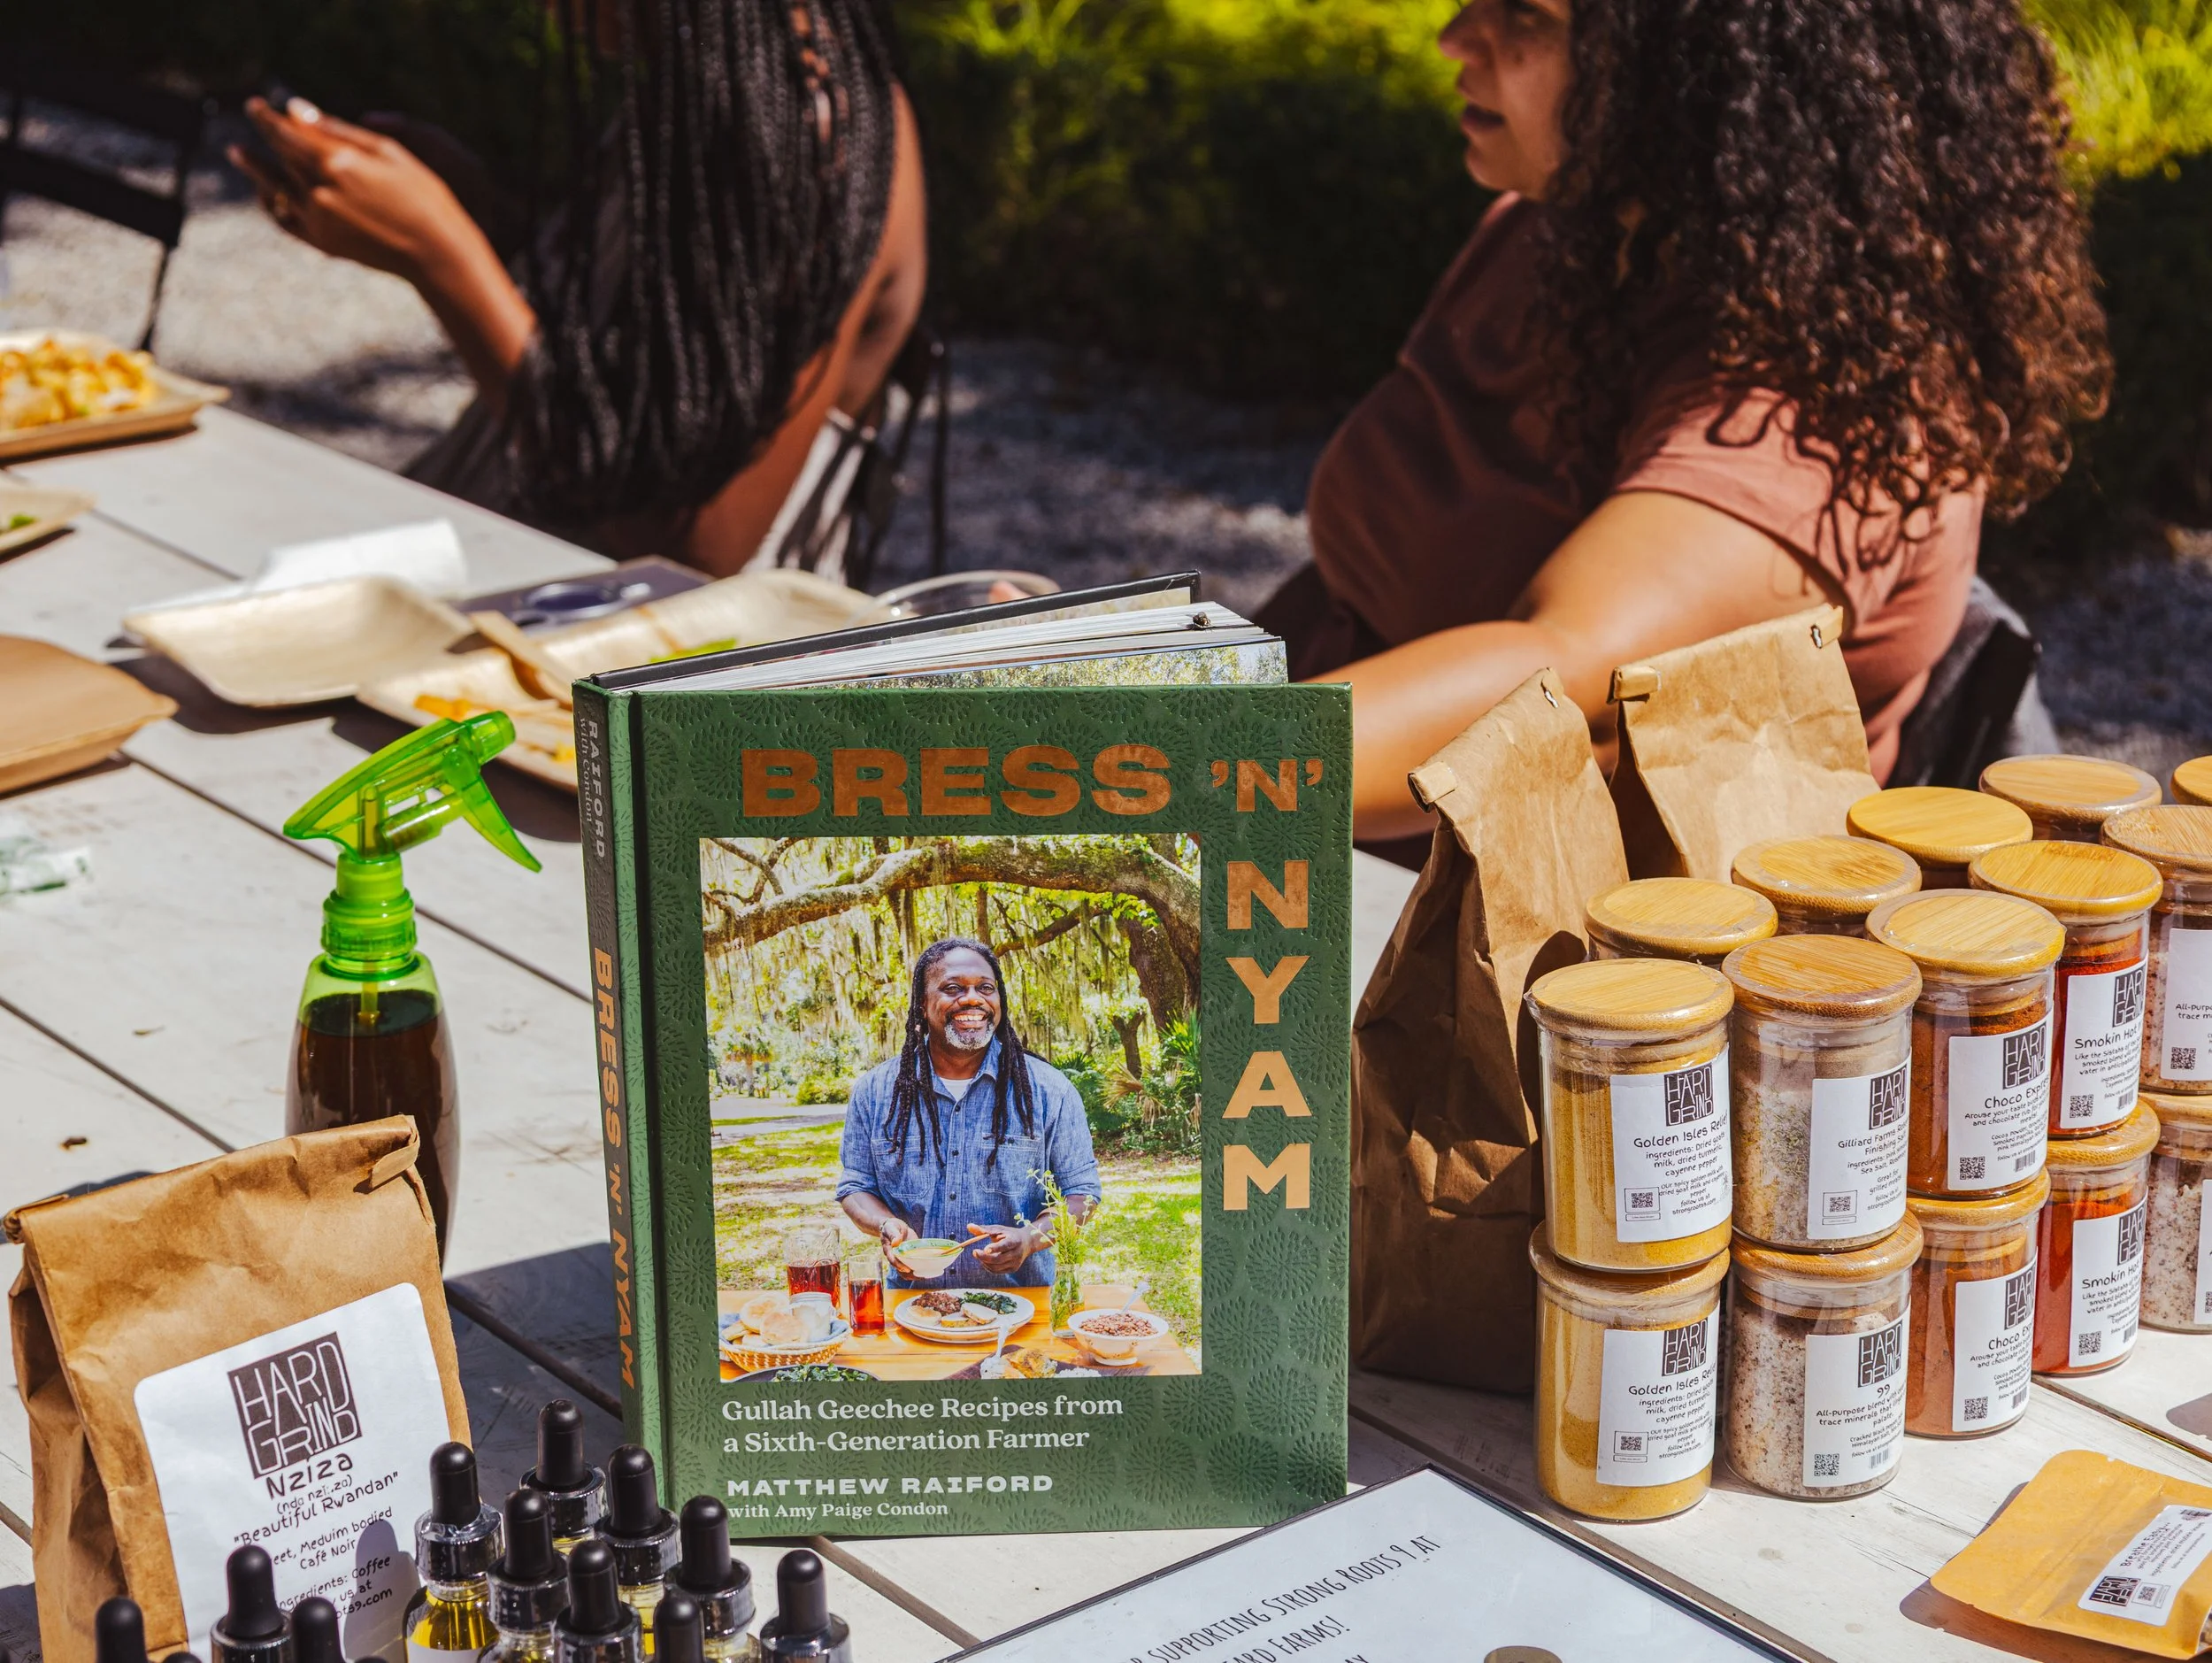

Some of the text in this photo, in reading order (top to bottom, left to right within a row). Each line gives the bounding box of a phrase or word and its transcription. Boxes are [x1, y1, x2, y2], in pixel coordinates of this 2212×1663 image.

[580, 718, 592, 822] with Condon
[741, 744, 1172, 817] BRESS
[588, 720, 605, 858] RAIFORD
[2176, 1003, 2212, 1012] All-purp
[1222, 859, 1312, 1211] NYAM
[2074, 1033, 2121, 1049] Smokin
[2124, 1026, 2137, 1040] Hot
[2005, 1025, 2046, 1071] HARD
[2005, 1052, 2045, 1088] GRIND
[1666, 1066, 1712, 1108] HARD
[1667, 1093, 1713, 1125] GRIND
[1985, 1094, 2023, 1109] Choco
[1993, 1109, 2008, 1120] your
[2010, 1103, 2026, 1113] taste
[1988, 1113, 2020, 1126] chocolate
[1633, 1135, 1679, 1148] Golden
[1683, 1128, 1708, 1141] Isles
[1838, 1137, 1872, 1149] Gilliard
[1864, 1140, 1896, 1156] Finishing
[1646, 1146, 1694, 1161] ingredients:
[1695, 1140, 1712, 1151] Dried
[1654, 1159, 1676, 1168] milk,
[1678, 1154, 1697, 1165] dried
[595, 947, 621, 1148] BRESS
[613, 1228, 634, 1390] NYAM
[1665, 1156, 1717, 1177] cayenne pepper
[1877, 1173, 1892, 1182] Great
[1676, 1186, 1689, 1195] goat
[1690, 1188, 1707, 1198] pepper
[1870, 1183, 1887, 1195] grilled
[2081, 1270, 2126, 1289] Smokin
[2089, 1296, 2114, 1306] smoked
[1665, 1319, 1707, 1360] HARD
[1861, 1323, 1902, 1369] HARD
[1988, 1333, 2020, 1351] Choco
[1664, 1345, 1707, 1375] GRIND
[1970, 1353, 1994, 1362] Arouse
[1996, 1348, 2008, 1359] your
[1992, 1351, 2017, 1366] chocolate
[1860, 1351, 1901, 1387] GRIND
[234, 1341, 350, 1436] HARD
[1628, 1376, 1699, 1396] Golden Isles
[722, 1395, 1123, 1421] Gullah Geechee Recipes from
[1639, 1390, 1701, 1408] ingredients: Dried
[1646, 1405, 1666, 1414] milk,
[1669, 1402, 1686, 1413] dried
[1816, 1405, 1865, 1417] All-purpose
[1867, 1398, 1886, 1411] blend
[1655, 1403, 1706, 1424] cayenne pepper
[1844, 1411, 1878, 1423] minerals
[1879, 1404, 1892, 1414] that
[247, 1397, 358, 1475] GRIND
[723, 1428, 1090, 1452] a Sixth-Generation Farmer
[1663, 1426, 1678, 1435] spicy
[1664, 1431, 1677, 1440] goat
[1678, 1428, 1689, 1436] milk
[1849, 1432, 1871, 1443] Cracked
[266, 1452, 353, 1499] Nziza
[727, 1475, 1053, 1496] MATTHEW RAIFORD
[234, 1471, 398, 1546] "Beautiful Rwandan"
[277, 1497, 304, 1514] (nda
[728, 1502, 949, 1521] with Amy Paige Condon
[273, 1506, 393, 1566] eet, Meduim bodied
[300, 1538, 357, 1570] Café Noir
[279, 1556, 391, 1611] ngredients: Coffee
[340, 1589, 355, 1602] us
[358, 1580, 373, 1594] at
[1148, 1608, 1271, 1663] SUPPORTING
[1261, 1577, 1347, 1615] STRONG
[1335, 1553, 1402, 1583] ROOTS
[1409, 1536, 1440, 1553] AT
[1268, 1615, 1350, 1654] FARMS!
